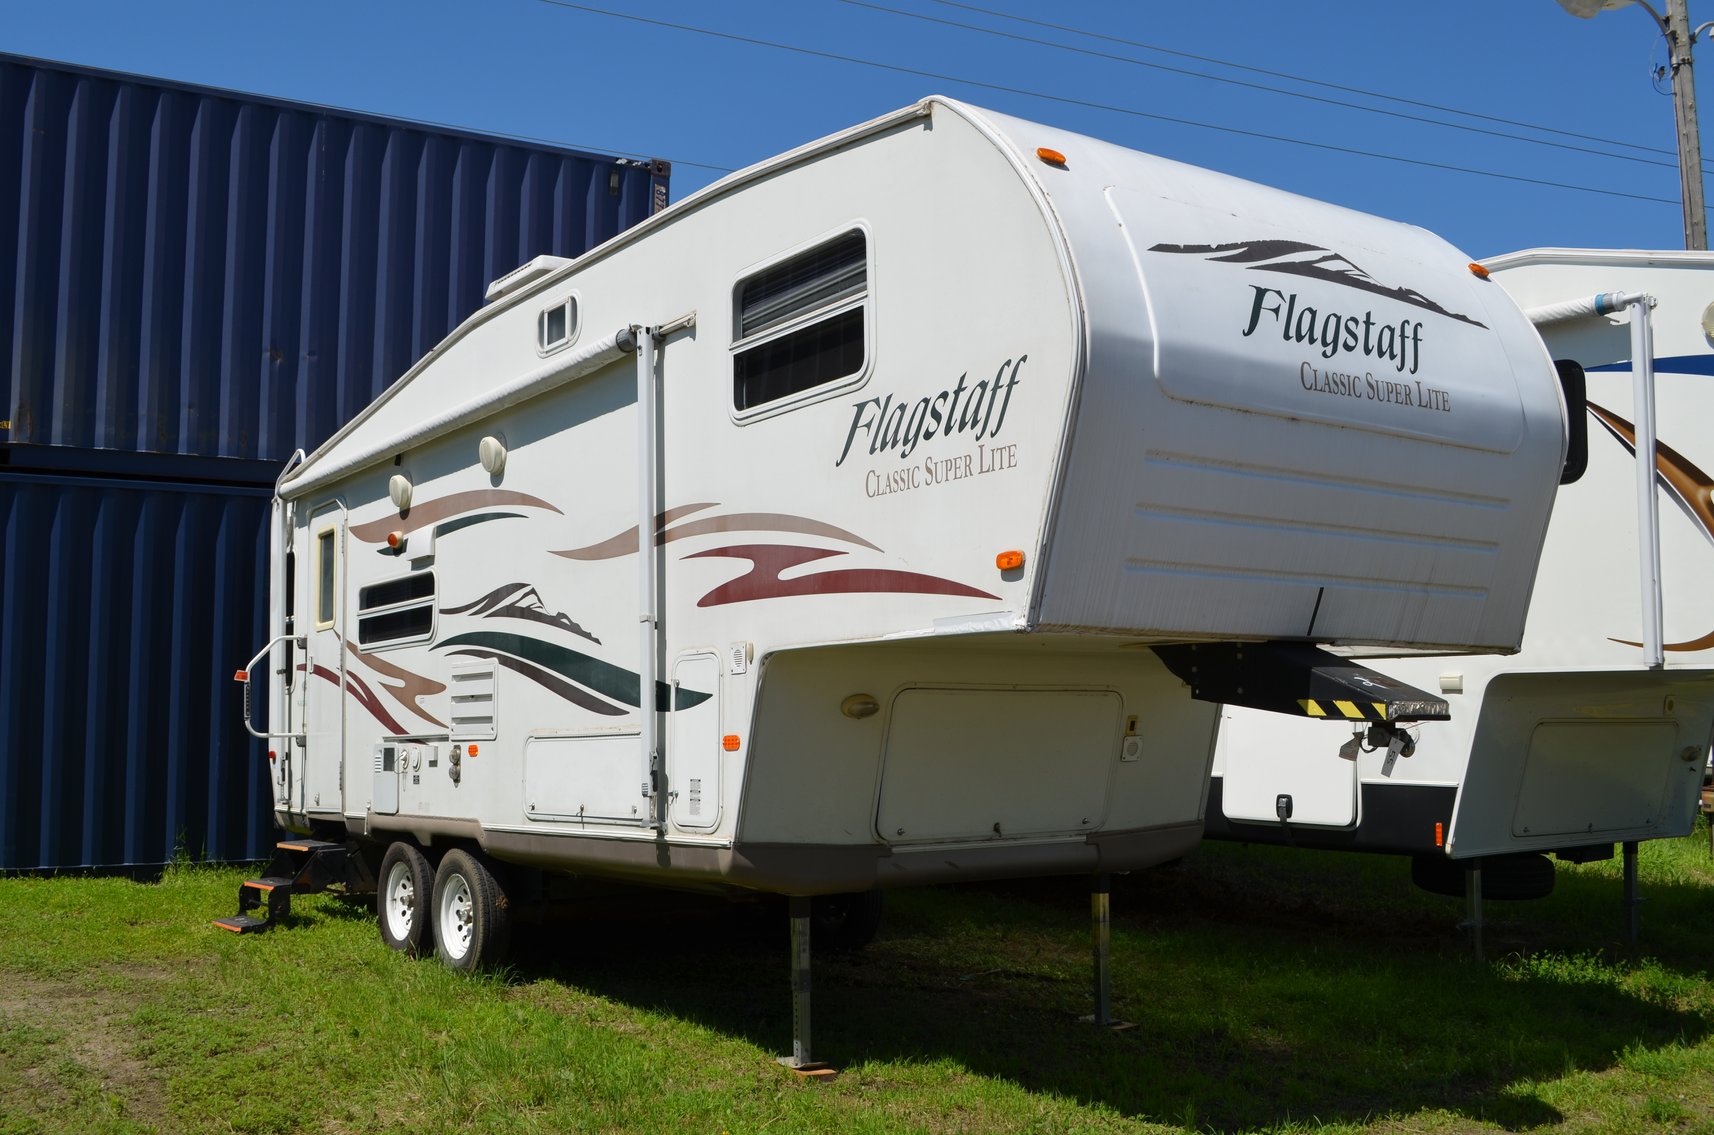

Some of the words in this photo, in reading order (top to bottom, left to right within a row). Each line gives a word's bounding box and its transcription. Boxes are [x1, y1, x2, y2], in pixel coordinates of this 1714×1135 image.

[1242, 284, 1423, 374] Flagstaff
[836, 354, 1028, 467] Flagstaff
[1300, 361, 1362, 398] CLASSIC
[1365, 372, 1413, 406] SUPER
[1415, 381, 1451, 412] LITE
[865, 465, 920, 498] CLASSIC
[925, 454, 973, 486] SUPER
[978, 444, 1018, 474] LITE
